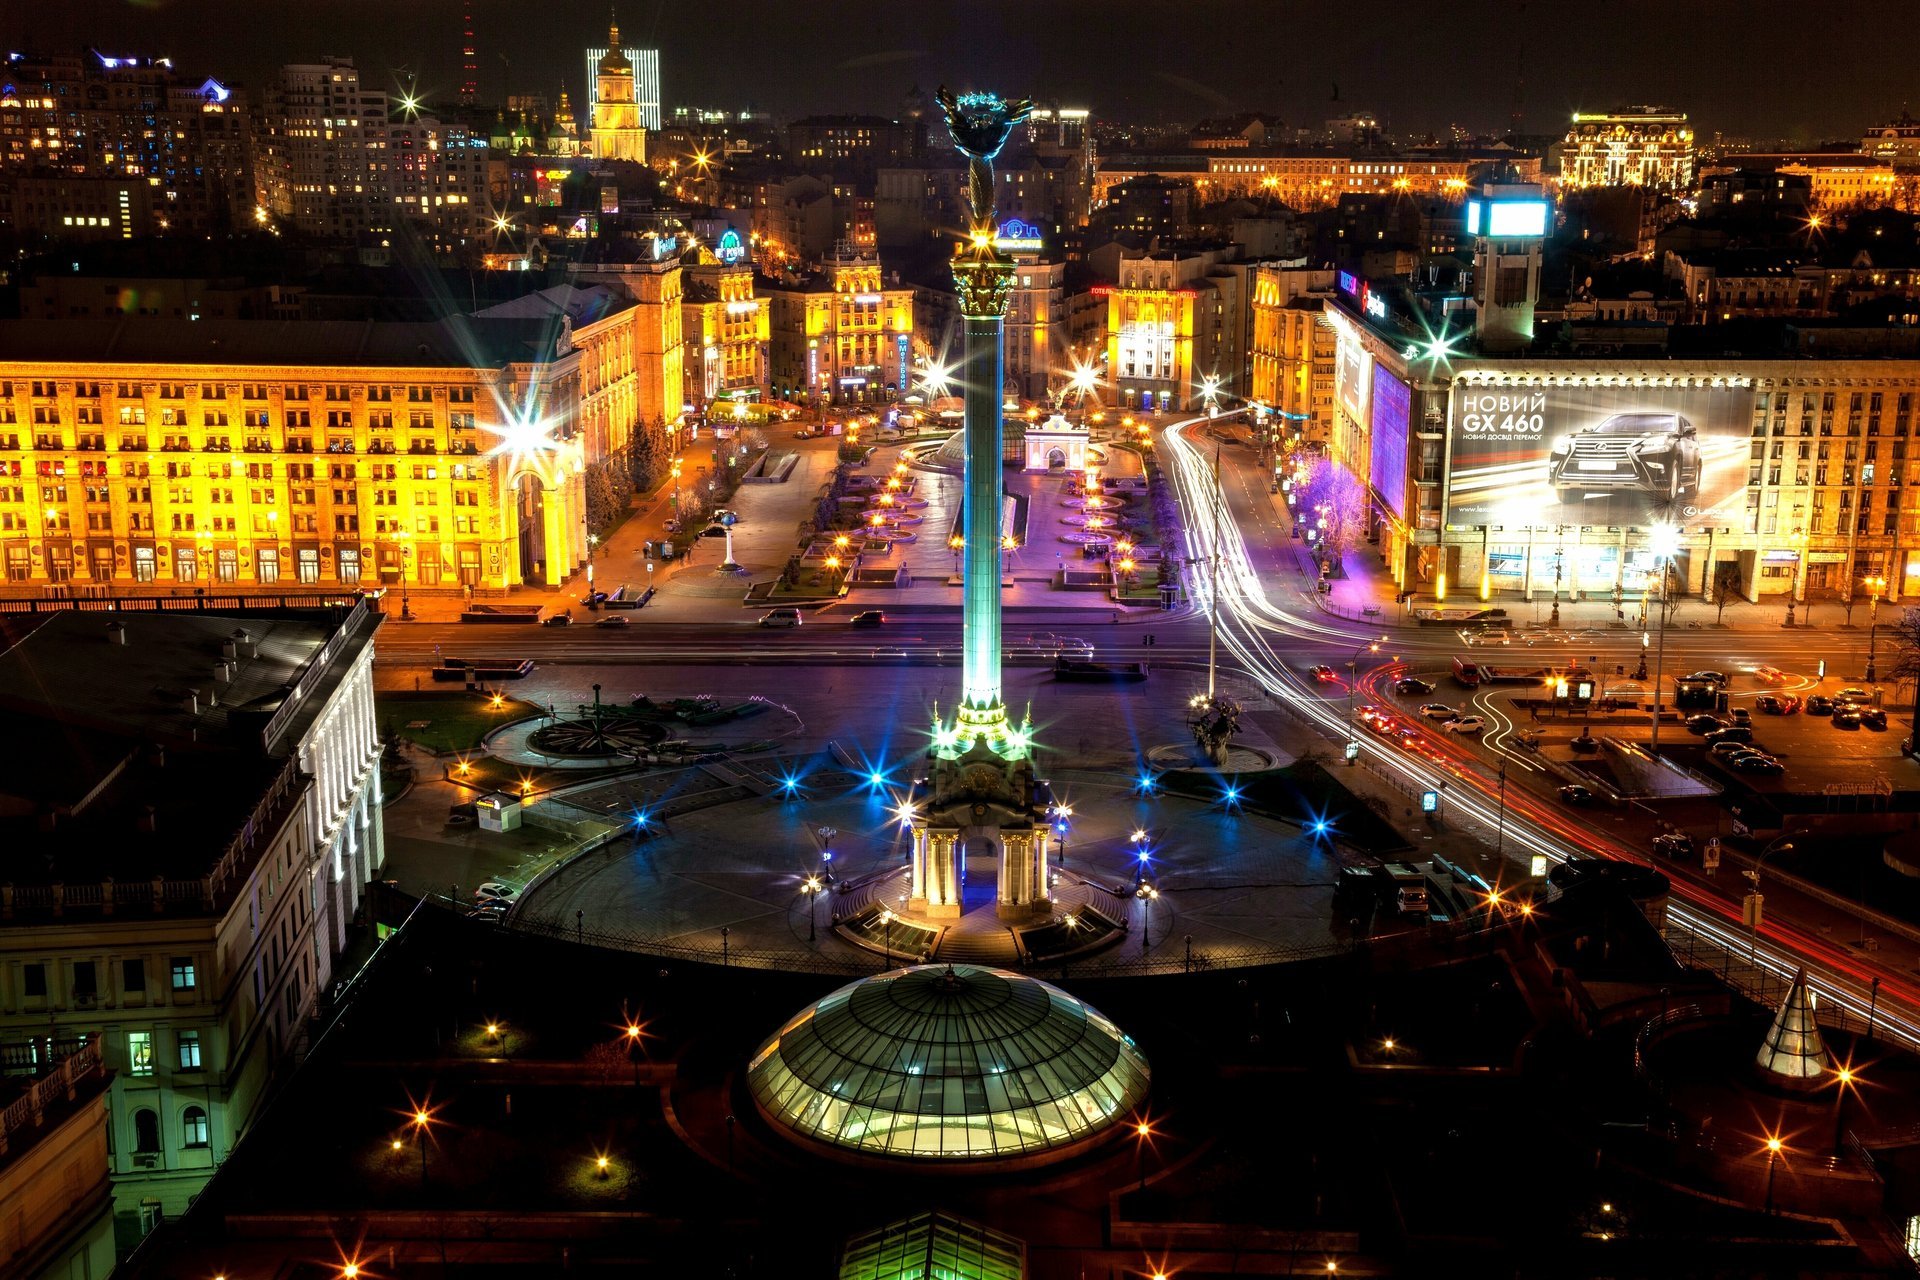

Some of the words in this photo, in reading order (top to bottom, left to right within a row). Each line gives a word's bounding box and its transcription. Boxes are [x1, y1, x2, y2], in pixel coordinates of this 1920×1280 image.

[1091, 287, 1114, 295] ГОТЕЛЬ
[1123, 289, 1168, 298] КОЗАЦЬКИЙ
[1177, 291, 1197, 299] HOTEL
[1463, 392, 1546, 412] НОВИЙ
[1462, 413, 1497, 432] GX
[1499, 413, 1544, 433] 460
[1462, 432, 1487, 440] НОВИЙ
[1487, 433, 1512, 441] ДОСВІД
[1513, 433, 1543, 441] ПЕРЕМОГ
